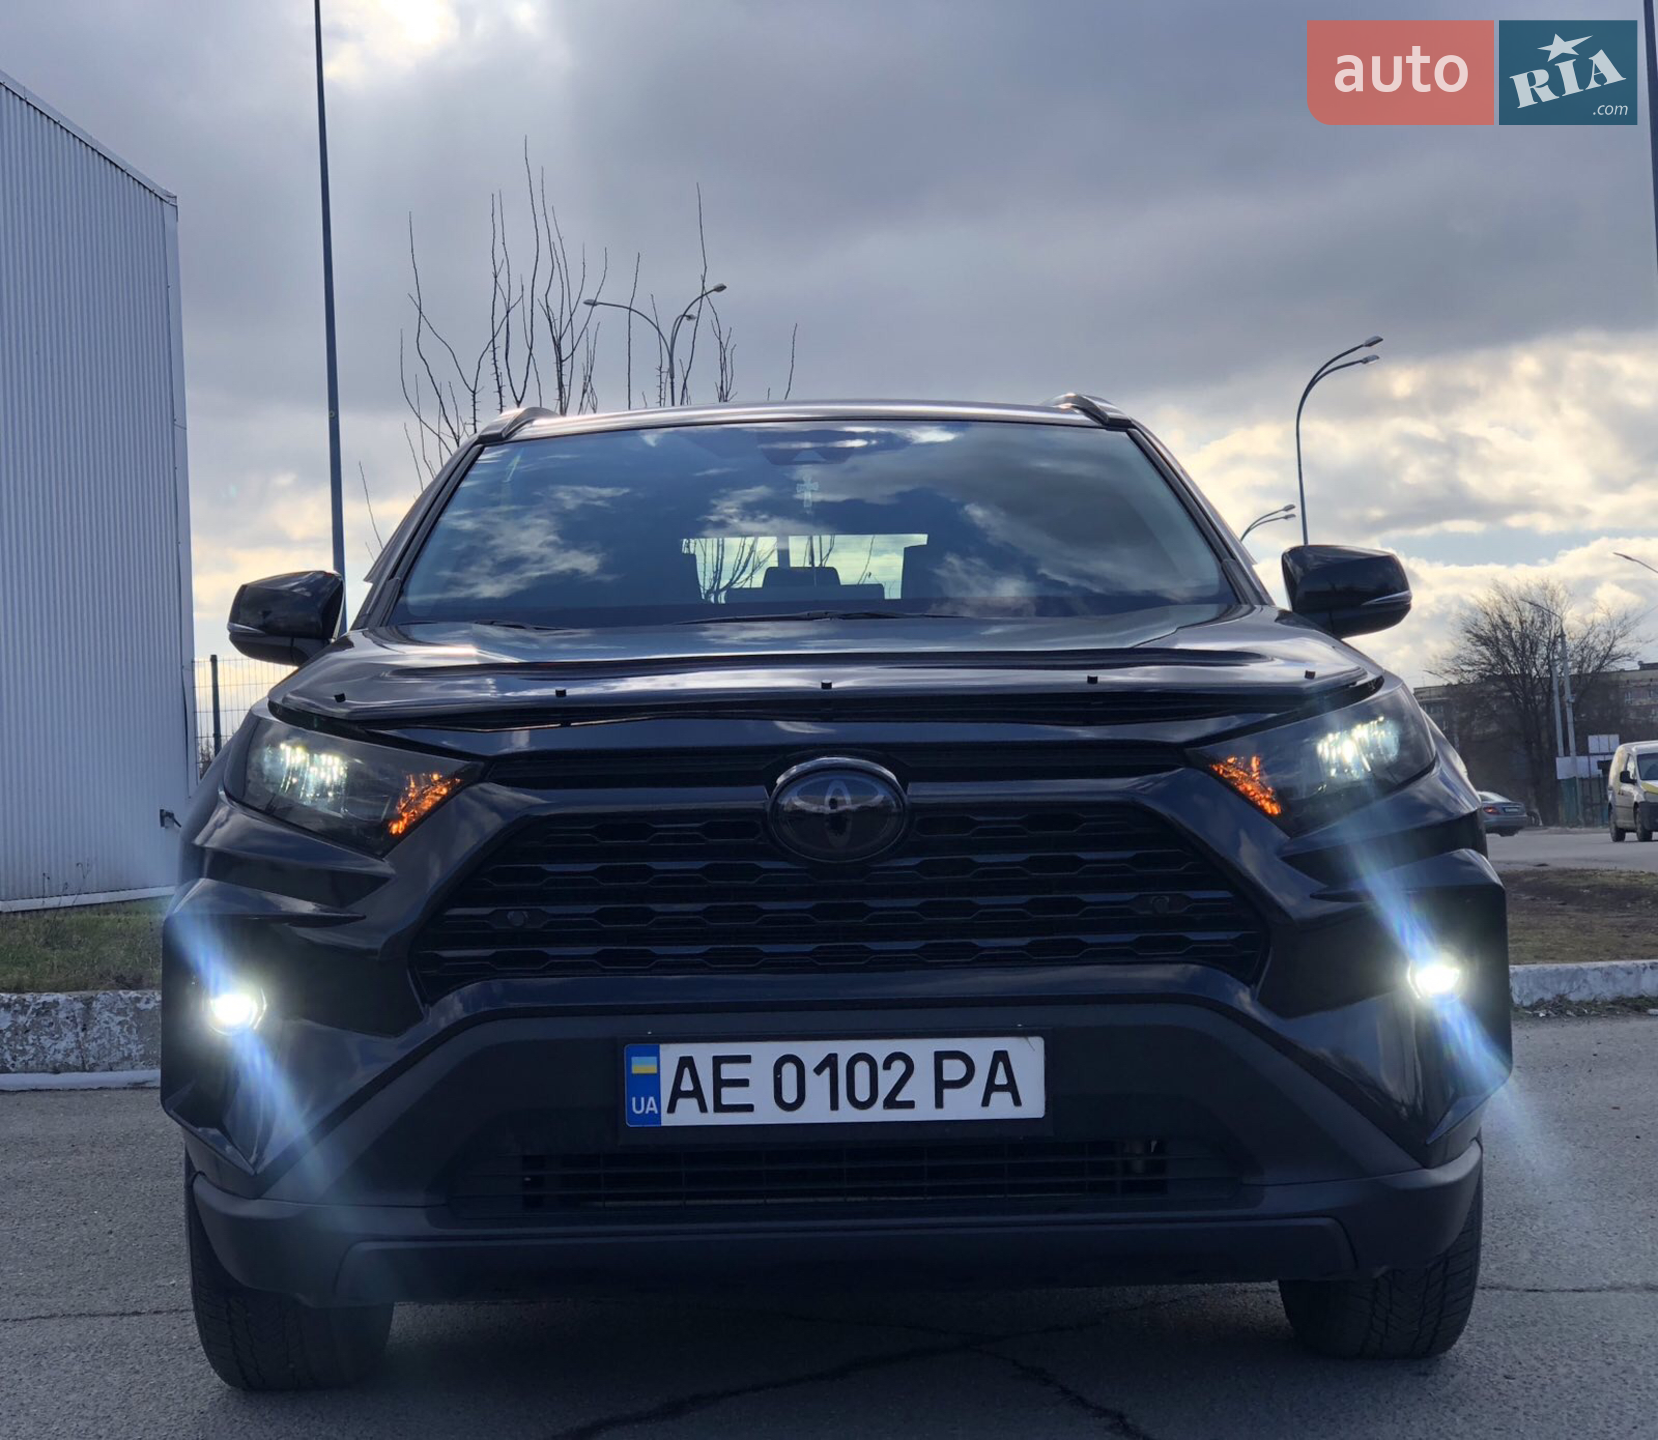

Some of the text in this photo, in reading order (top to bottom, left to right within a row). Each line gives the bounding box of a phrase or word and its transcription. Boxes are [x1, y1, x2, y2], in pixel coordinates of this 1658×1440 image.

[666, 1049, 1023, 1114] AE 0102 PA
[631, 1096, 659, 1115] UA
